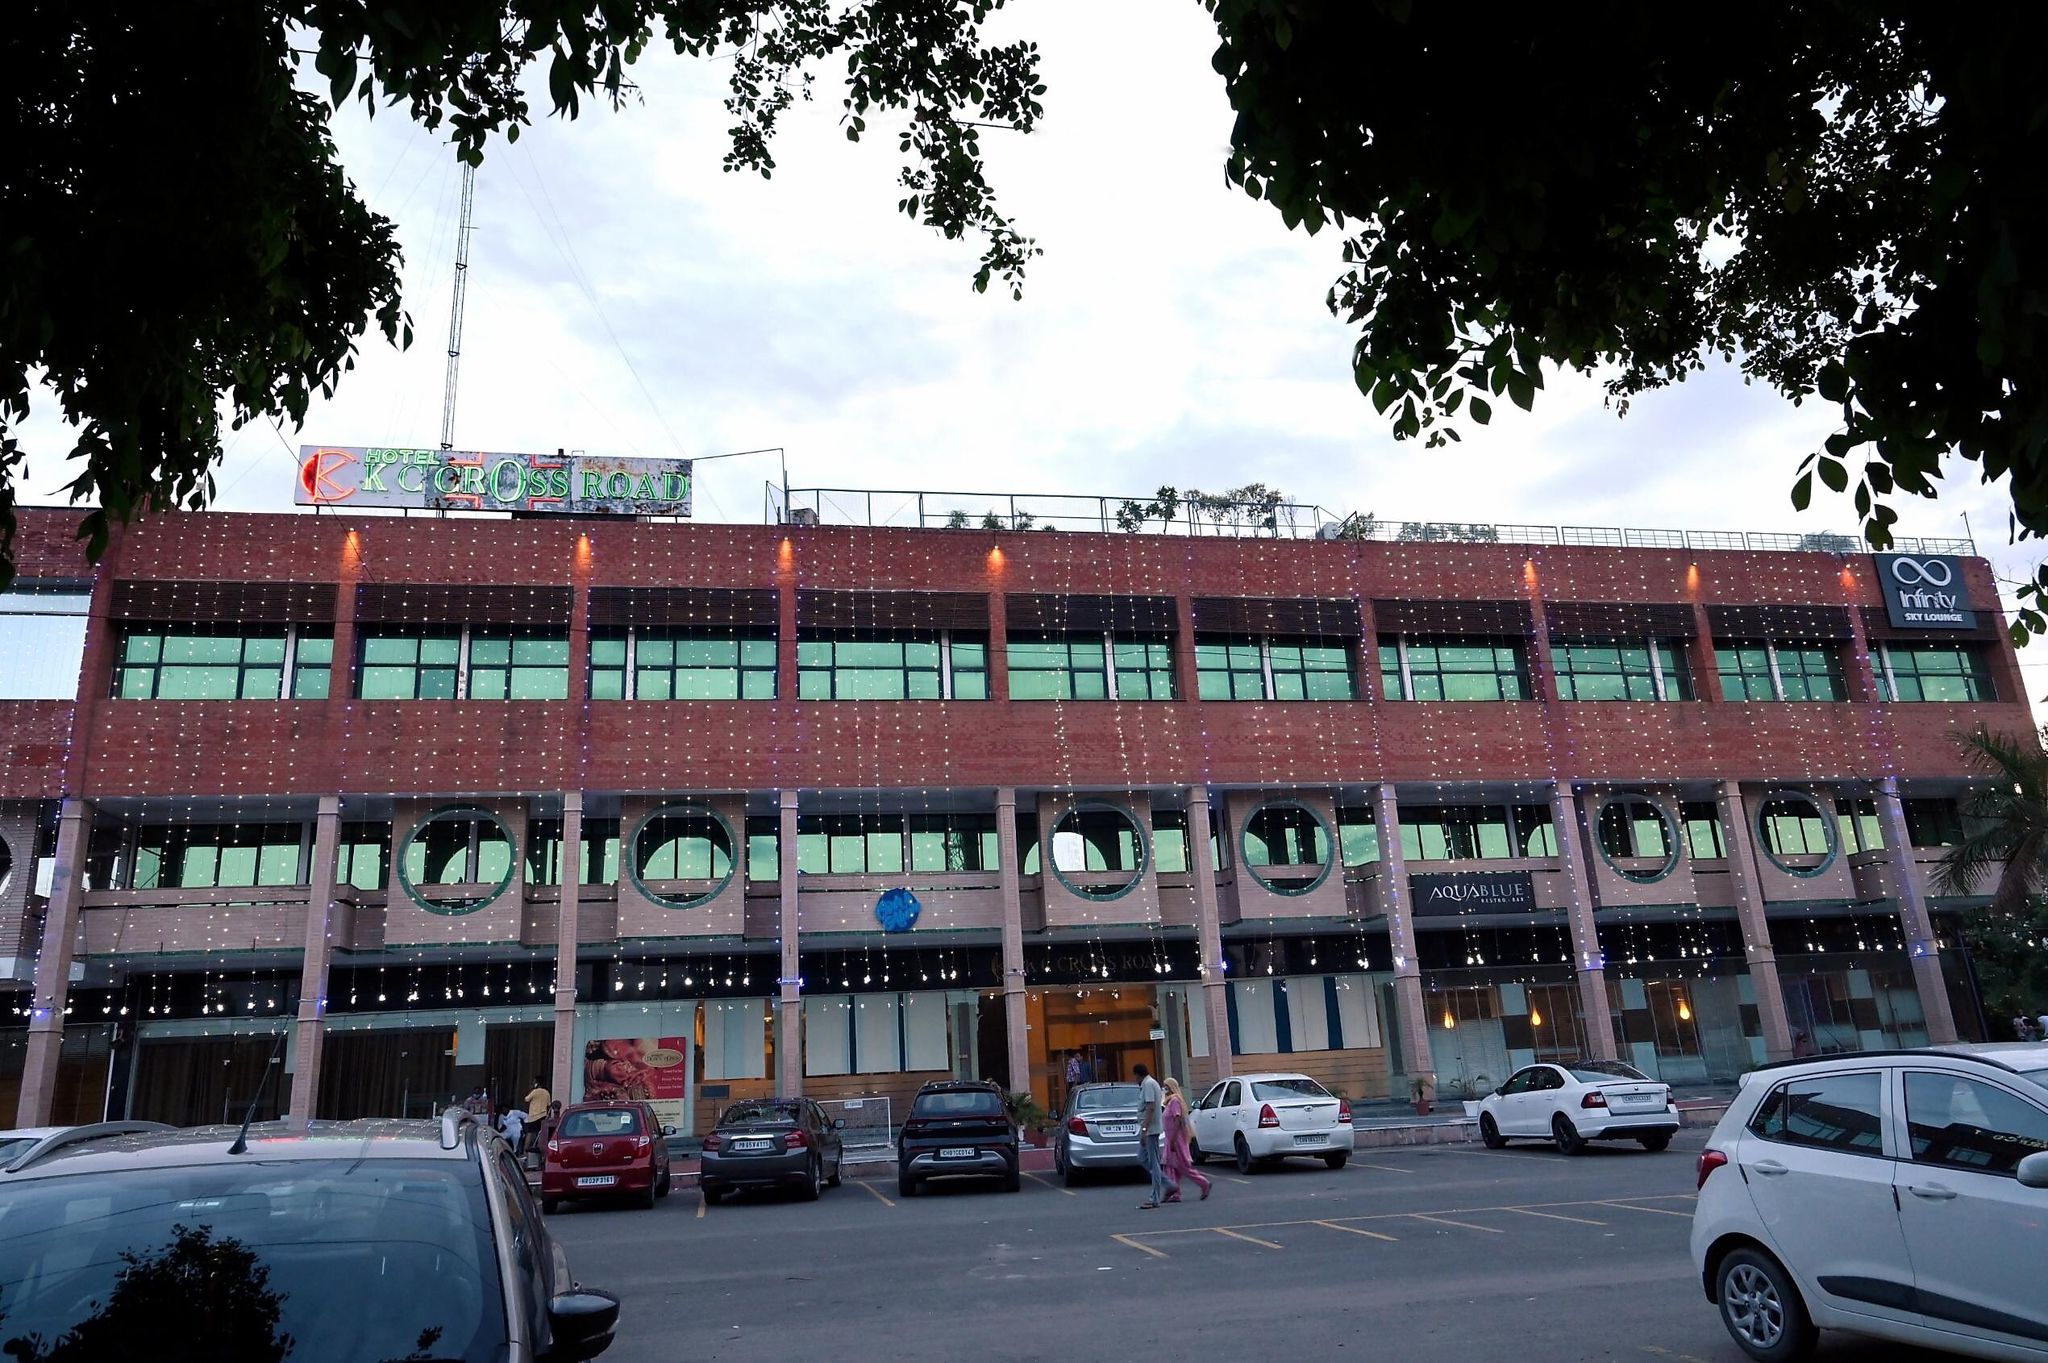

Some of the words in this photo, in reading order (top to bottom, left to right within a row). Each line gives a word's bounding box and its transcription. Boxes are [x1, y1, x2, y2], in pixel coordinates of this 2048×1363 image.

[365, 448, 440, 465] HOTEL
[434, 459, 569, 503] CROSS
[580, 469, 689, 501] ROAD
[1899, 588, 1956, 613] Infinity
[1904, 612, 1922, 621] SKY
[1924, 613, 1963, 622] LOUNGE
